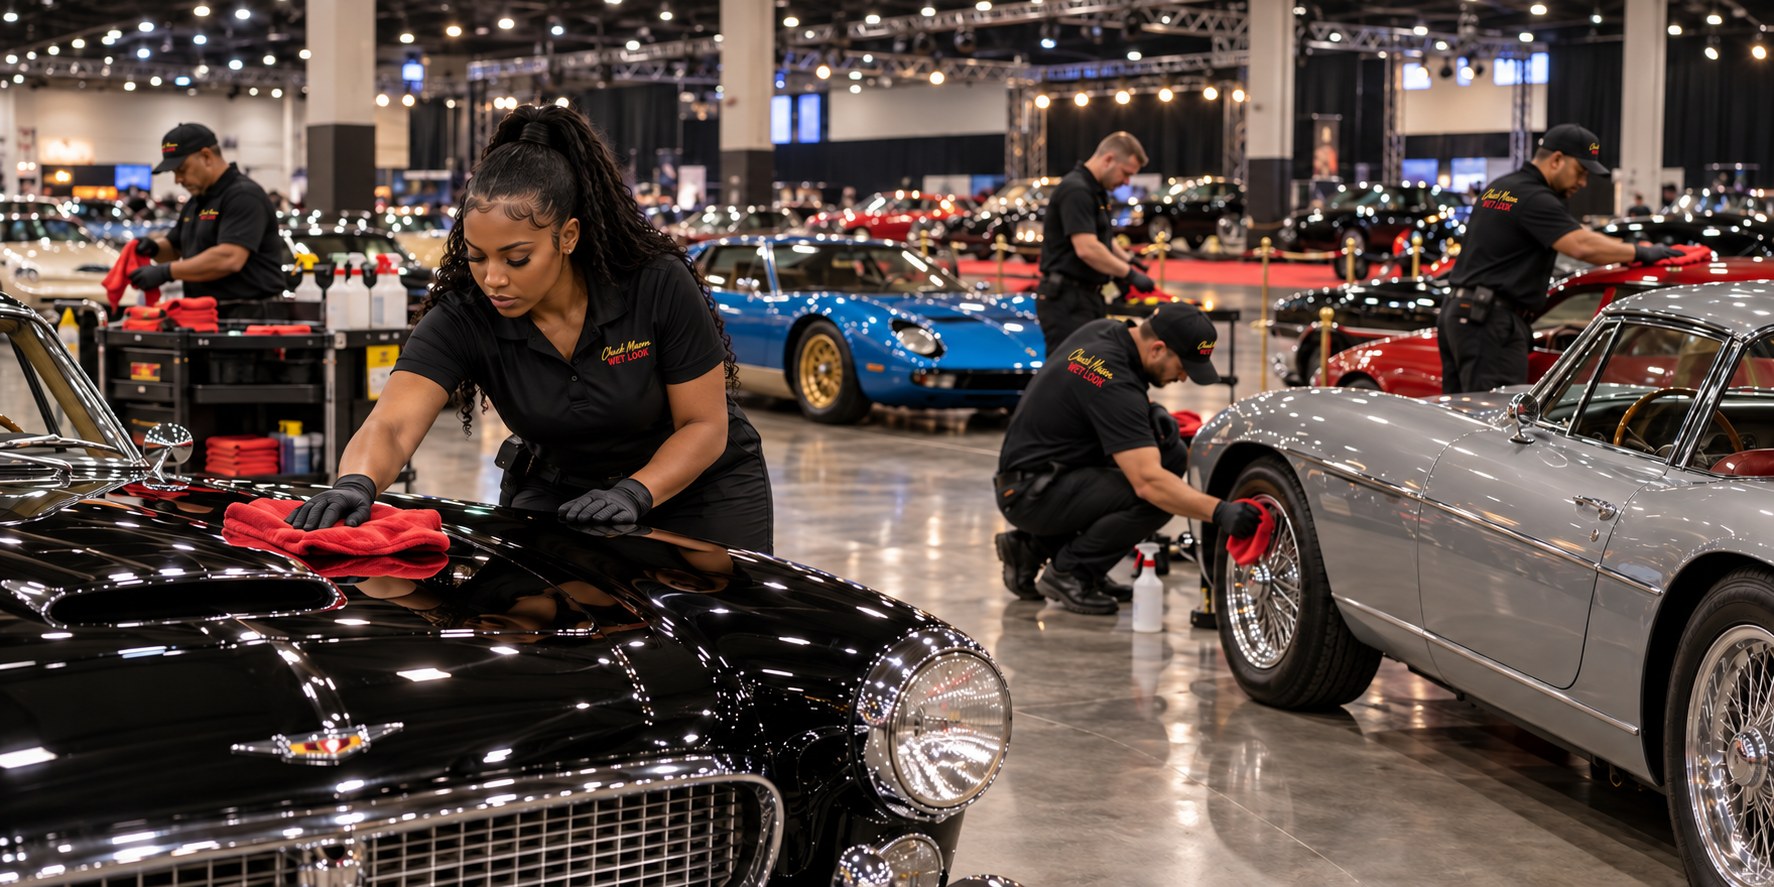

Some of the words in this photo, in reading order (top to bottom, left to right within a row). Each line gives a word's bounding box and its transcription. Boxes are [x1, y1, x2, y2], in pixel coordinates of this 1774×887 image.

[601, 342, 625, 361] Chuck
[626, 340, 651, 353] Mason
[607, 354, 625, 367] WET
[627, 347, 649, 361] LOOK
[1067, 348, 1095, 365] Chuck
[1067, 362, 1086, 375] WET
[1082, 370, 1106, 388] LOOK
